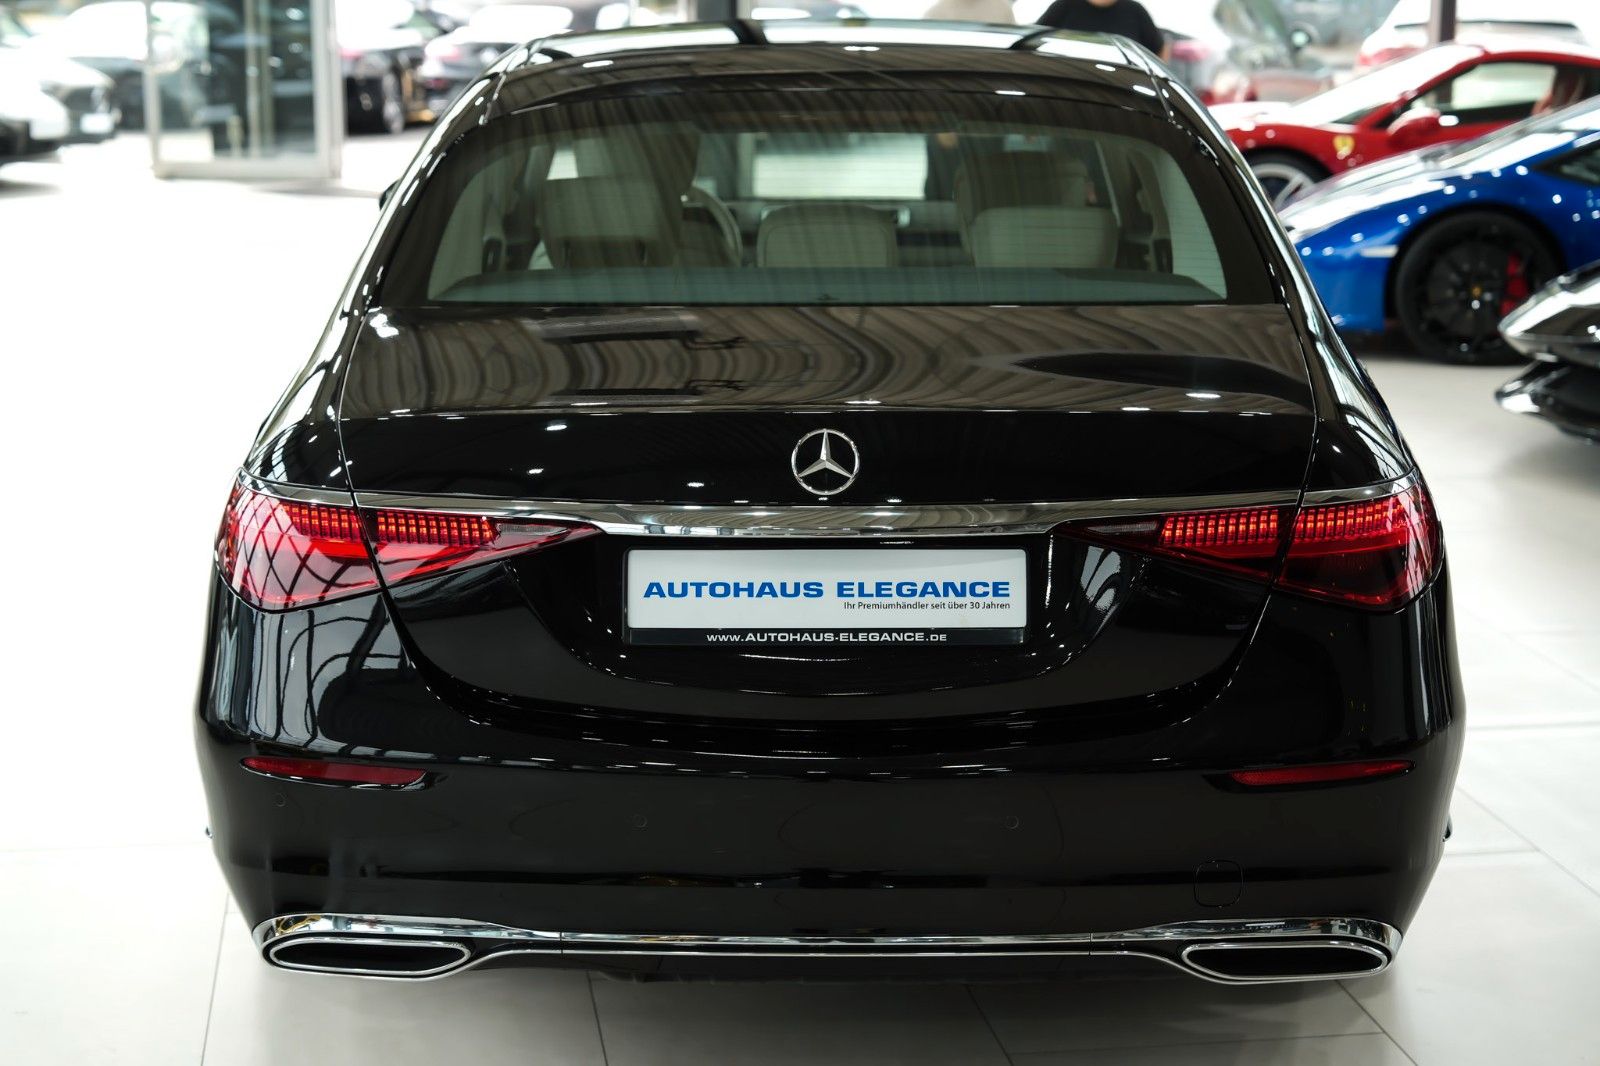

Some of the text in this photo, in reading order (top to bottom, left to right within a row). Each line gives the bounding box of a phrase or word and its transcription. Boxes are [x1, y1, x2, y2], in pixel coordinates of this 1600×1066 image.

[643, 581, 1011, 599] AUTOHAUS ELEGANCE
[843, 600, 1011, 611] Ihr Premiumhändler seit über 30 Jahren
